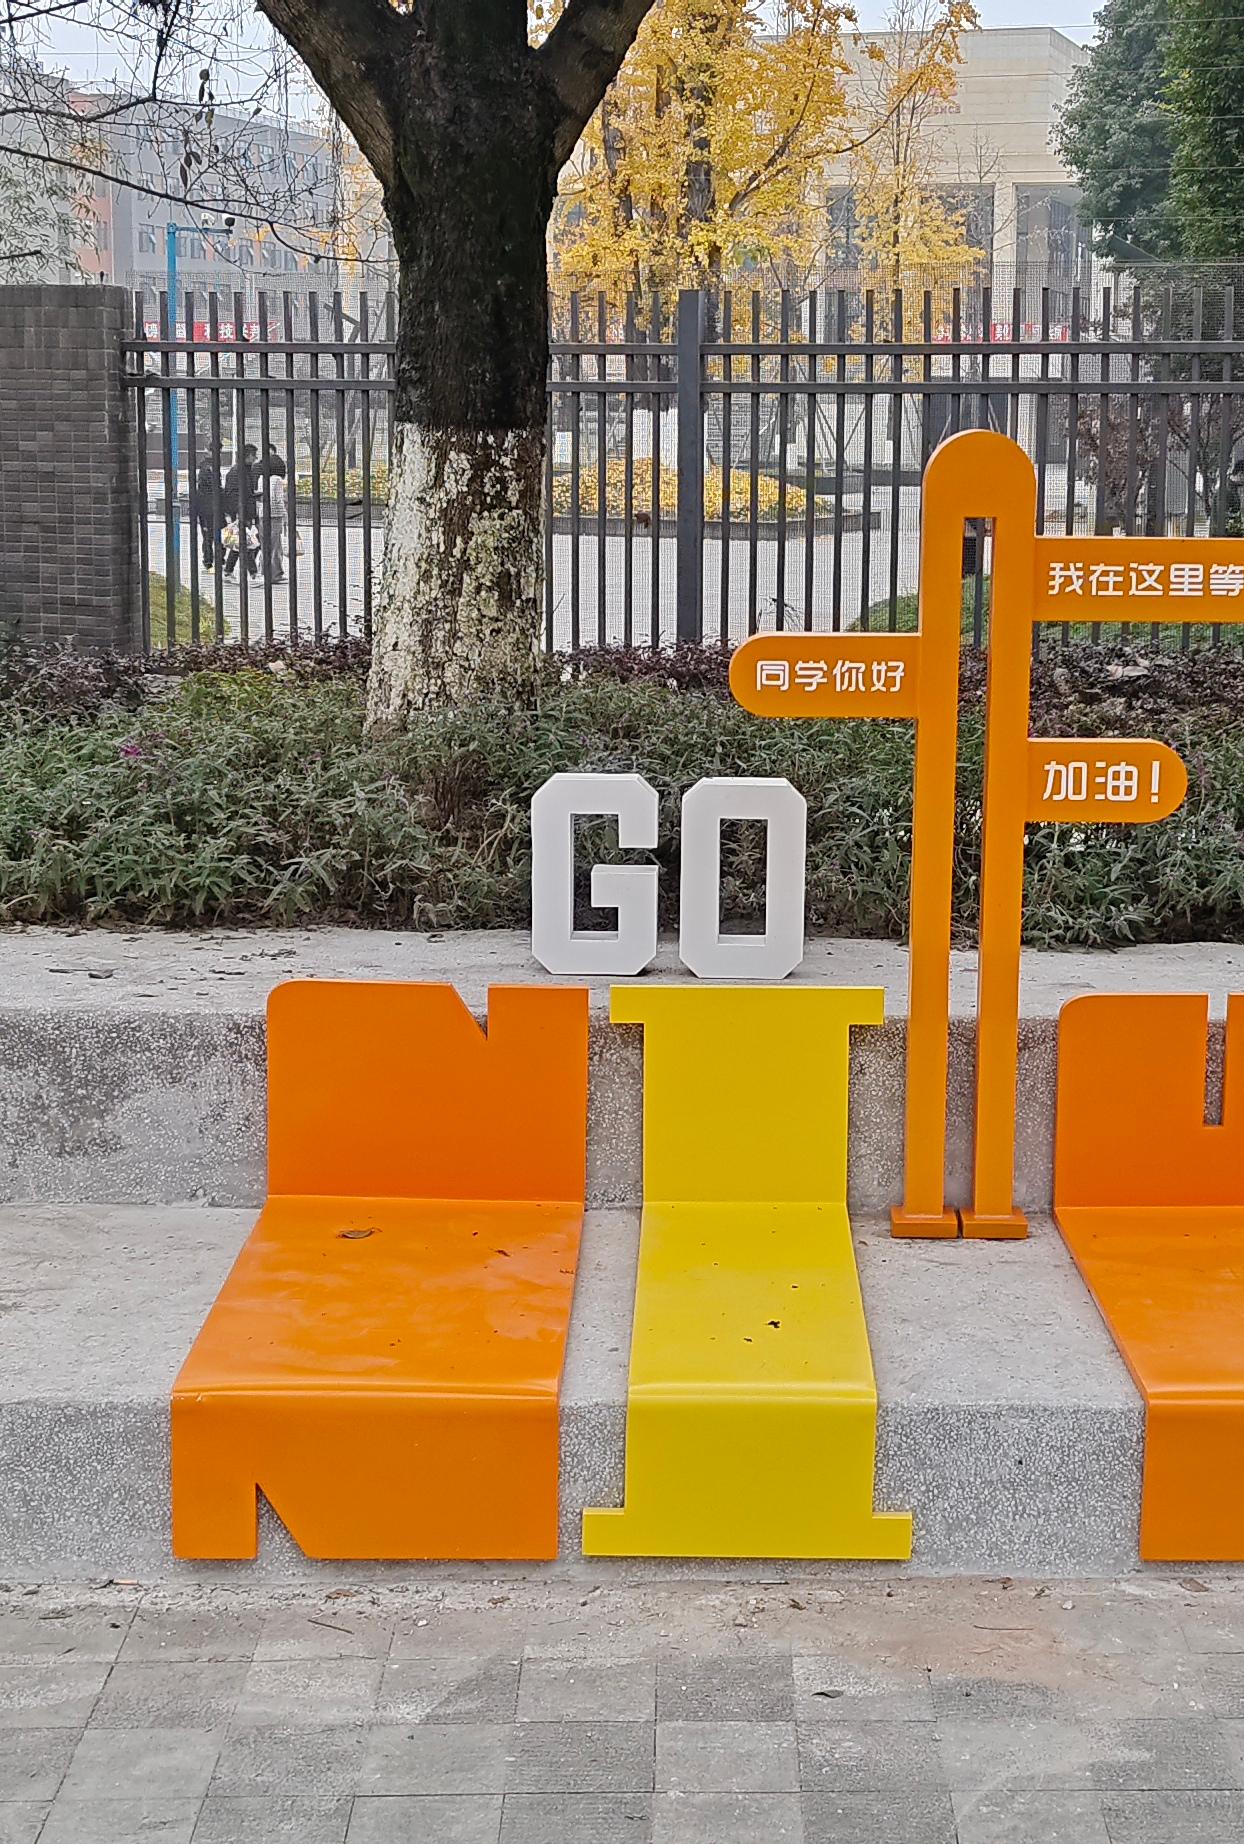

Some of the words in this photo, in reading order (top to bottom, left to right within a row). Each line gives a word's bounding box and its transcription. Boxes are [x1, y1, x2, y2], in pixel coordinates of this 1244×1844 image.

[756, 660, 905, 692] 同学你好
[1042, 760, 1161, 803] 加油!
[530, 772, 807, 980] GO
